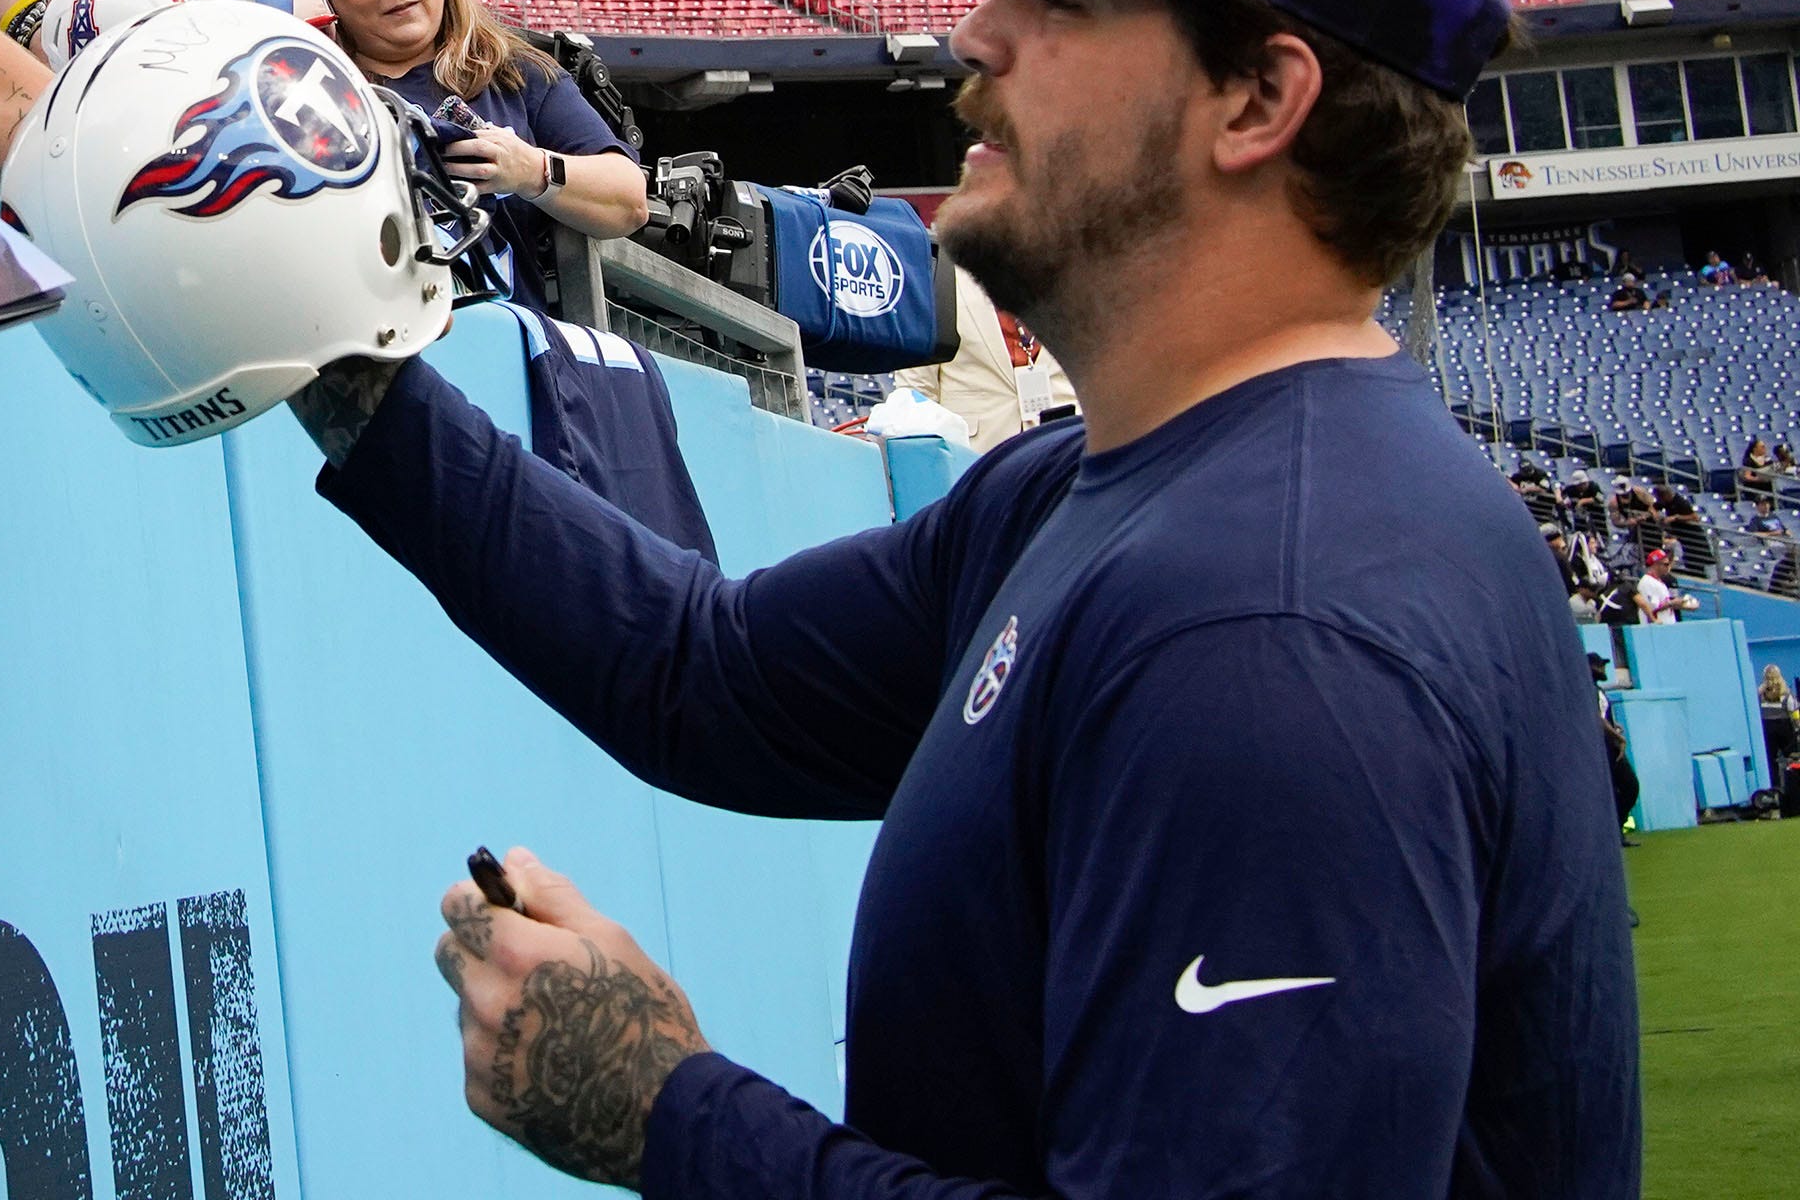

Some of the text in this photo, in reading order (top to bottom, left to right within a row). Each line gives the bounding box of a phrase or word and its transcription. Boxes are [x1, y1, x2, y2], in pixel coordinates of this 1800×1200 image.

[1540, 160, 1651, 186] TENNESSEE
[1653, 156, 1712, 176] STATE
[722, 227, 745, 239] SONY
[1450, 219, 1618, 285] TITANS
[831, 237, 882, 283] FOX
[833, 275, 886, 300] SPORTS
[130, 387, 247, 442] TITANS
